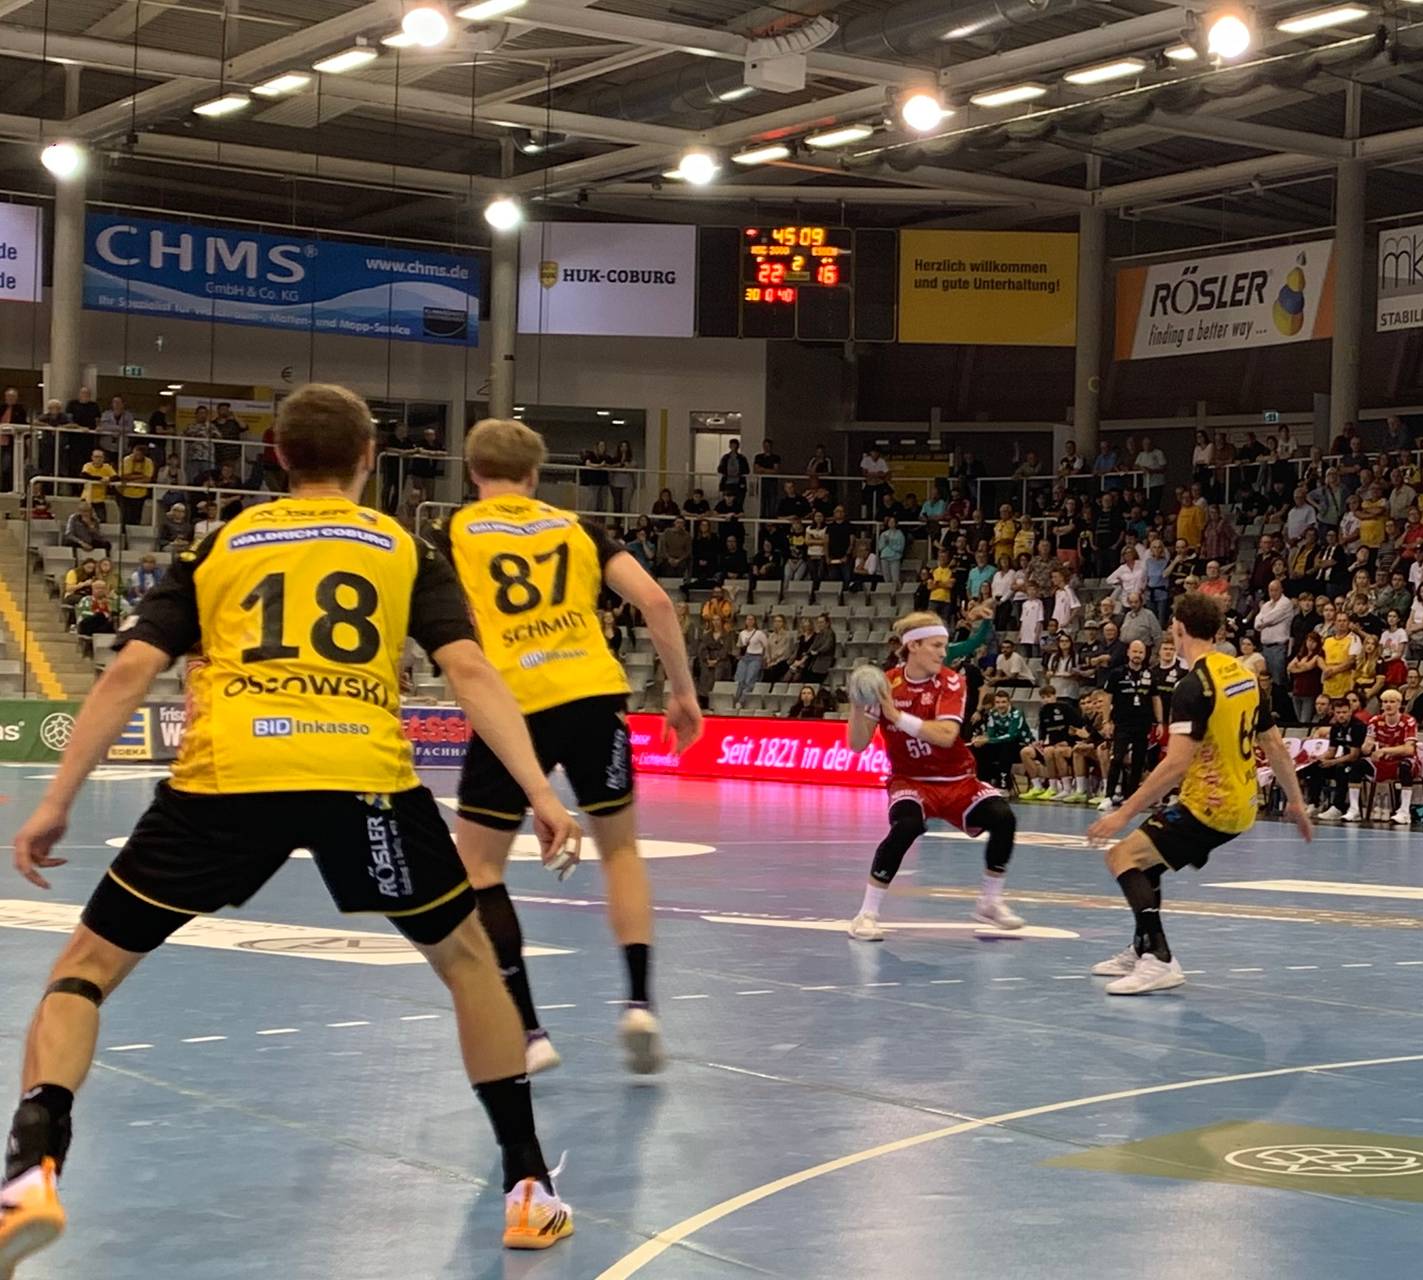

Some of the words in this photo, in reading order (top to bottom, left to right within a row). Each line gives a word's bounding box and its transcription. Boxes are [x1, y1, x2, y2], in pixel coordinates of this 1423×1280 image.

[365, 257, 470, 280] www.chms.de
[758, 263, 786, 284] 22
[791, 255, 804, 271] 2
[914, 258, 966, 273] Herzlich
[969, 260, 1048, 274] willkommen
[562, 267, 677, 285] HUK-COBURG
[817, 265, 839, 285] 16
[914, 276, 938, 290] und
[941, 278, 970, 293] gute
[973, 278, 1061, 294] Unterhaltung!
[205, 281, 245, 297] GmbH
[246, 286, 257, 299] &
[259, 286, 276, 301] Co.
[281, 288, 300, 302] KG
[744, 287, 761, 302] 30
[1149, 265, 1269, 318] RÖSLER
[1148, 321, 1185, 348] finding
[1186, 328, 1195, 342] a
[1196, 319, 1230, 341] better
[1231, 320, 1255, 340] way
[231, 527, 319, 548] WALDRICH
[320, 526, 392, 549] COBURG
[489, 541, 570, 615] 87
[239, 570, 381, 665] 18
[254, 719, 291, 736] BID
[296, 721, 371, 735] Inkasso
[716, 735, 755, 765] Seit
[754, 736, 801, 769] 1821
[800, 739, 820, 770] in
[822, 740, 853, 772] der
[366, 815, 400, 898] RÖSLER
